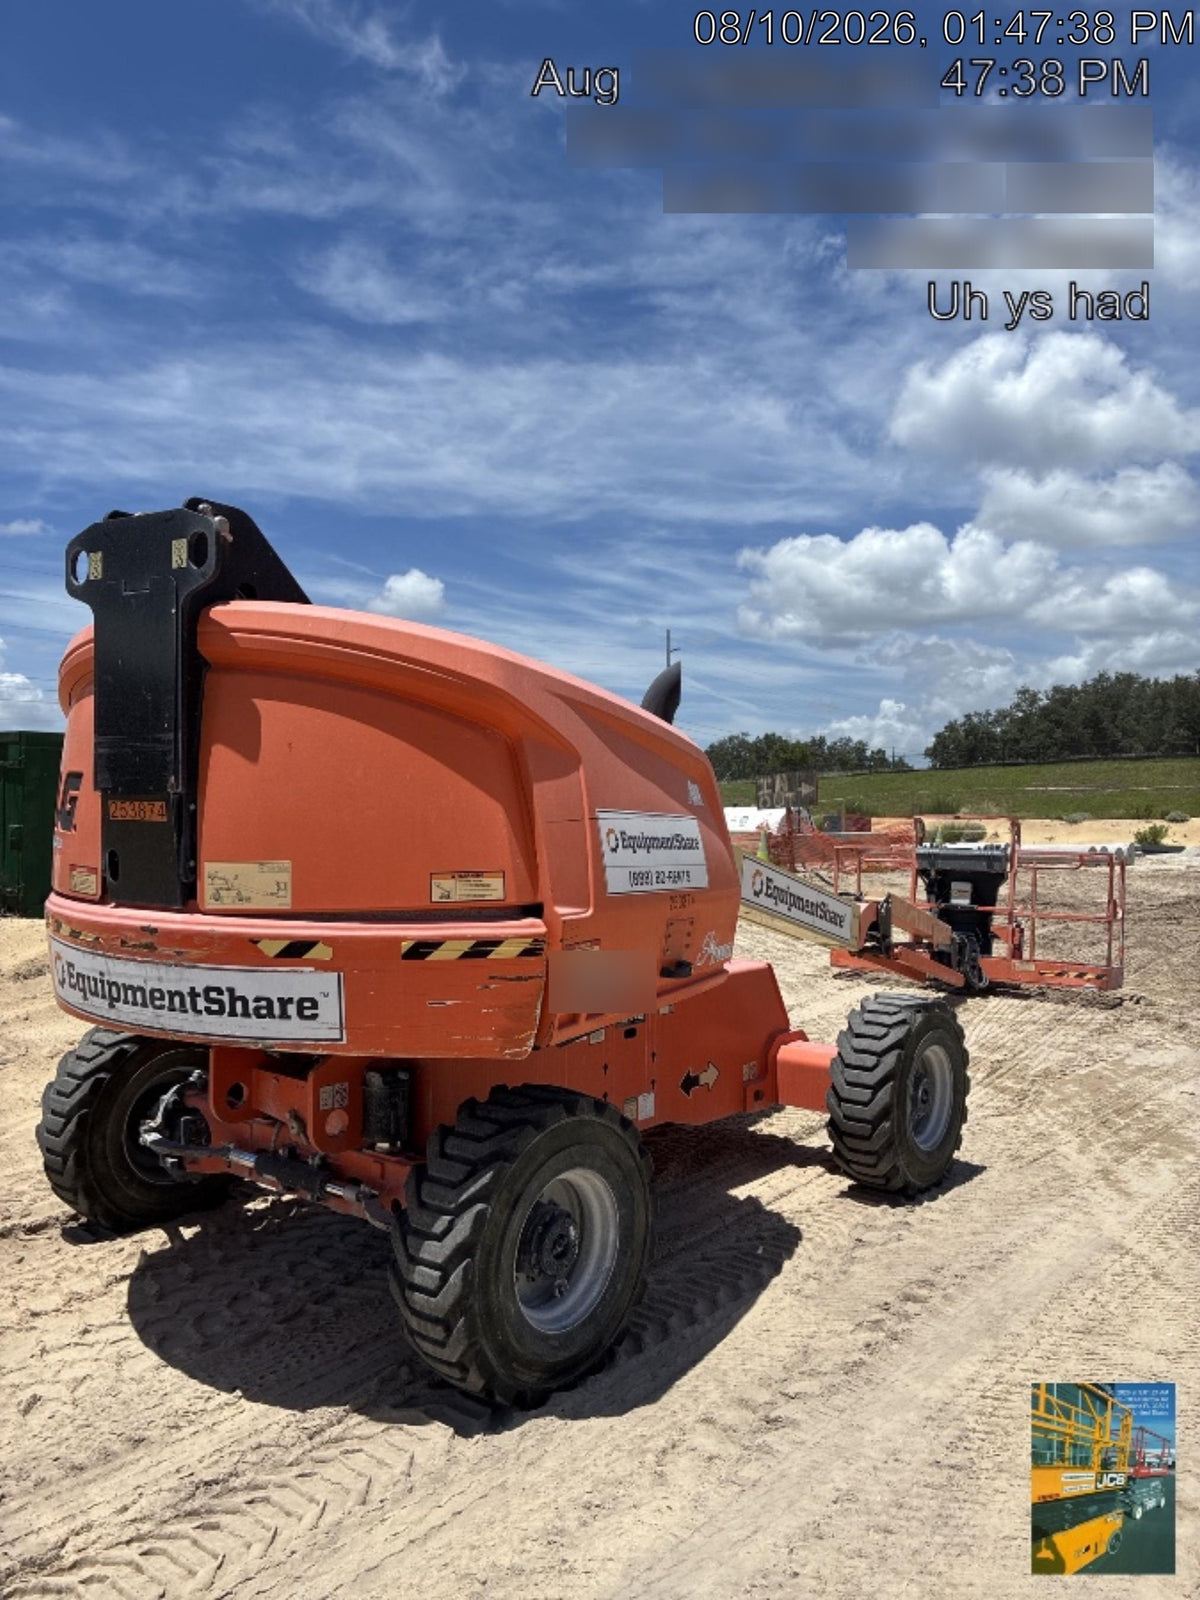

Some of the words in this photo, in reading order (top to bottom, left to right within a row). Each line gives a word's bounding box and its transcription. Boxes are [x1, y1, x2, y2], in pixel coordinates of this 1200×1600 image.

[619, 829, 700, 854] EquipmentShare
[764, 875, 846, 929] EquipmentShare
[65, 960, 320, 1021] EquipmentShare
